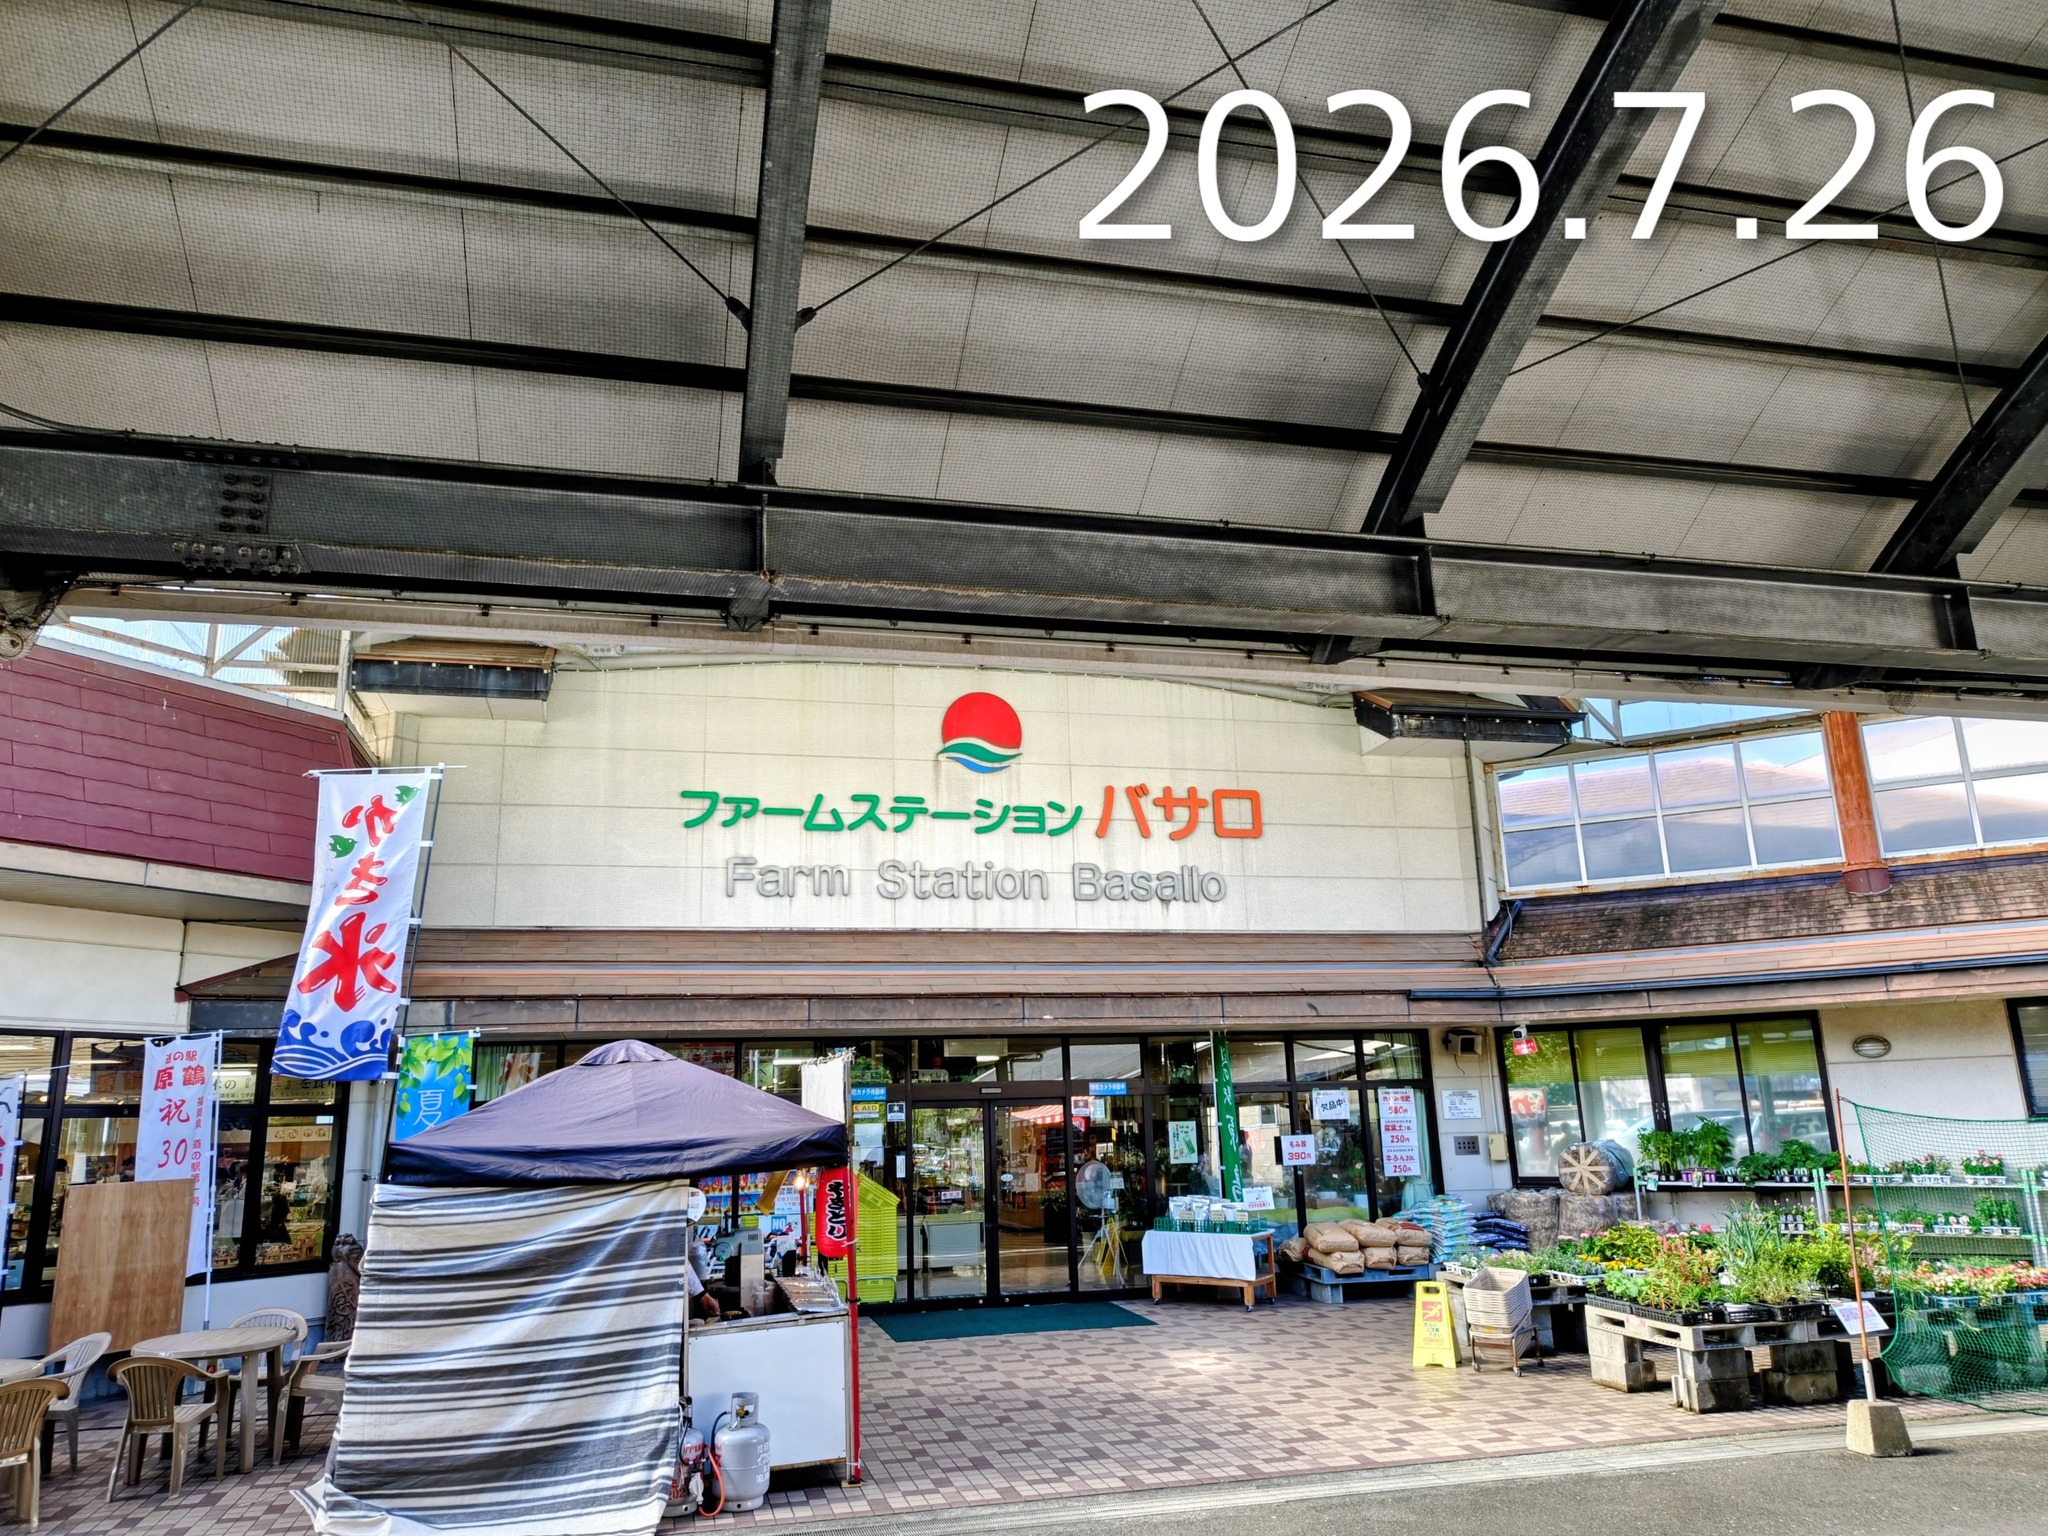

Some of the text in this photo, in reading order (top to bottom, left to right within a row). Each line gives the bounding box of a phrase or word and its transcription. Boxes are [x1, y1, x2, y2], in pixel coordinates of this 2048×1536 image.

[681, 783, 1263, 840] ファームステーション バサロ
[726, 857, 1227, 902] Farm Station Basallo
[297, 794, 397, 1012] かき氷
[165, 1050, 198, 1064] 道の駅
[154, 1064, 206, 1091] 原鶴
[159, 1098, 191, 1126] 祝
[418, 1089, 445, 1131] 夏
[1321, 1098, 1344, 1112] 欠品中
[1389, 1106, 1408, 1114] 580円
[1390, 1135, 1410, 1143] 250円
[158, 1138, 188, 1168] 30
[1288, 1152, 1312, 1160] 390円
[1393, 1165, 1412, 1173] 250円
